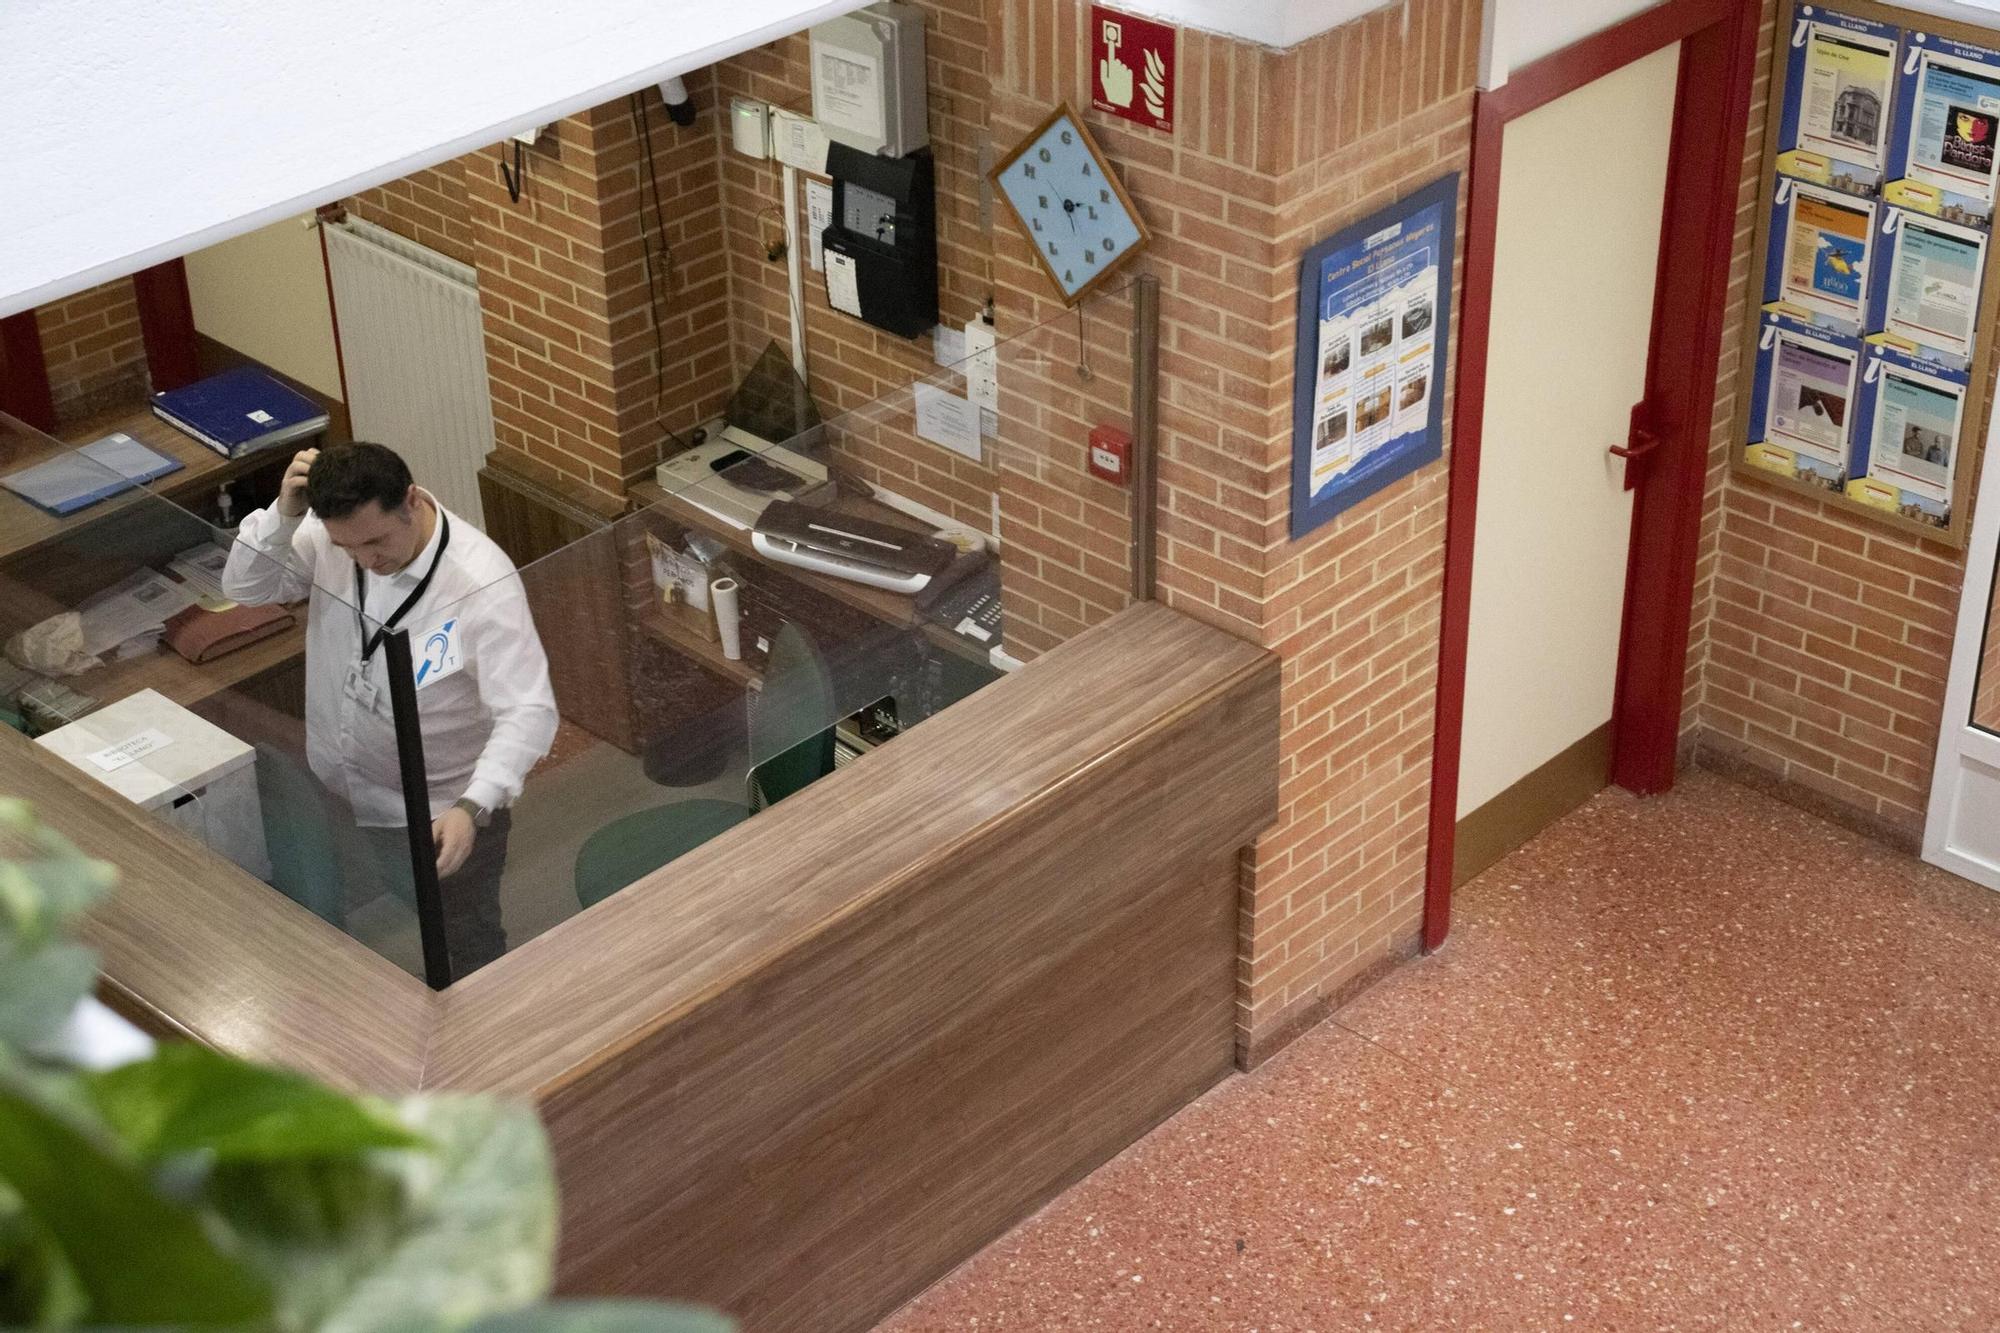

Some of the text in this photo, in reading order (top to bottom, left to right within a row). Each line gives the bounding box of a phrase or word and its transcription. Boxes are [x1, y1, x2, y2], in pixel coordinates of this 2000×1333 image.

[1848, 22, 1868, 33] LLANO
[1962, 50, 1984, 61] LLANO
[1944, 141, 1992, 167] Pandora
[449, 655, 455, 666] T
